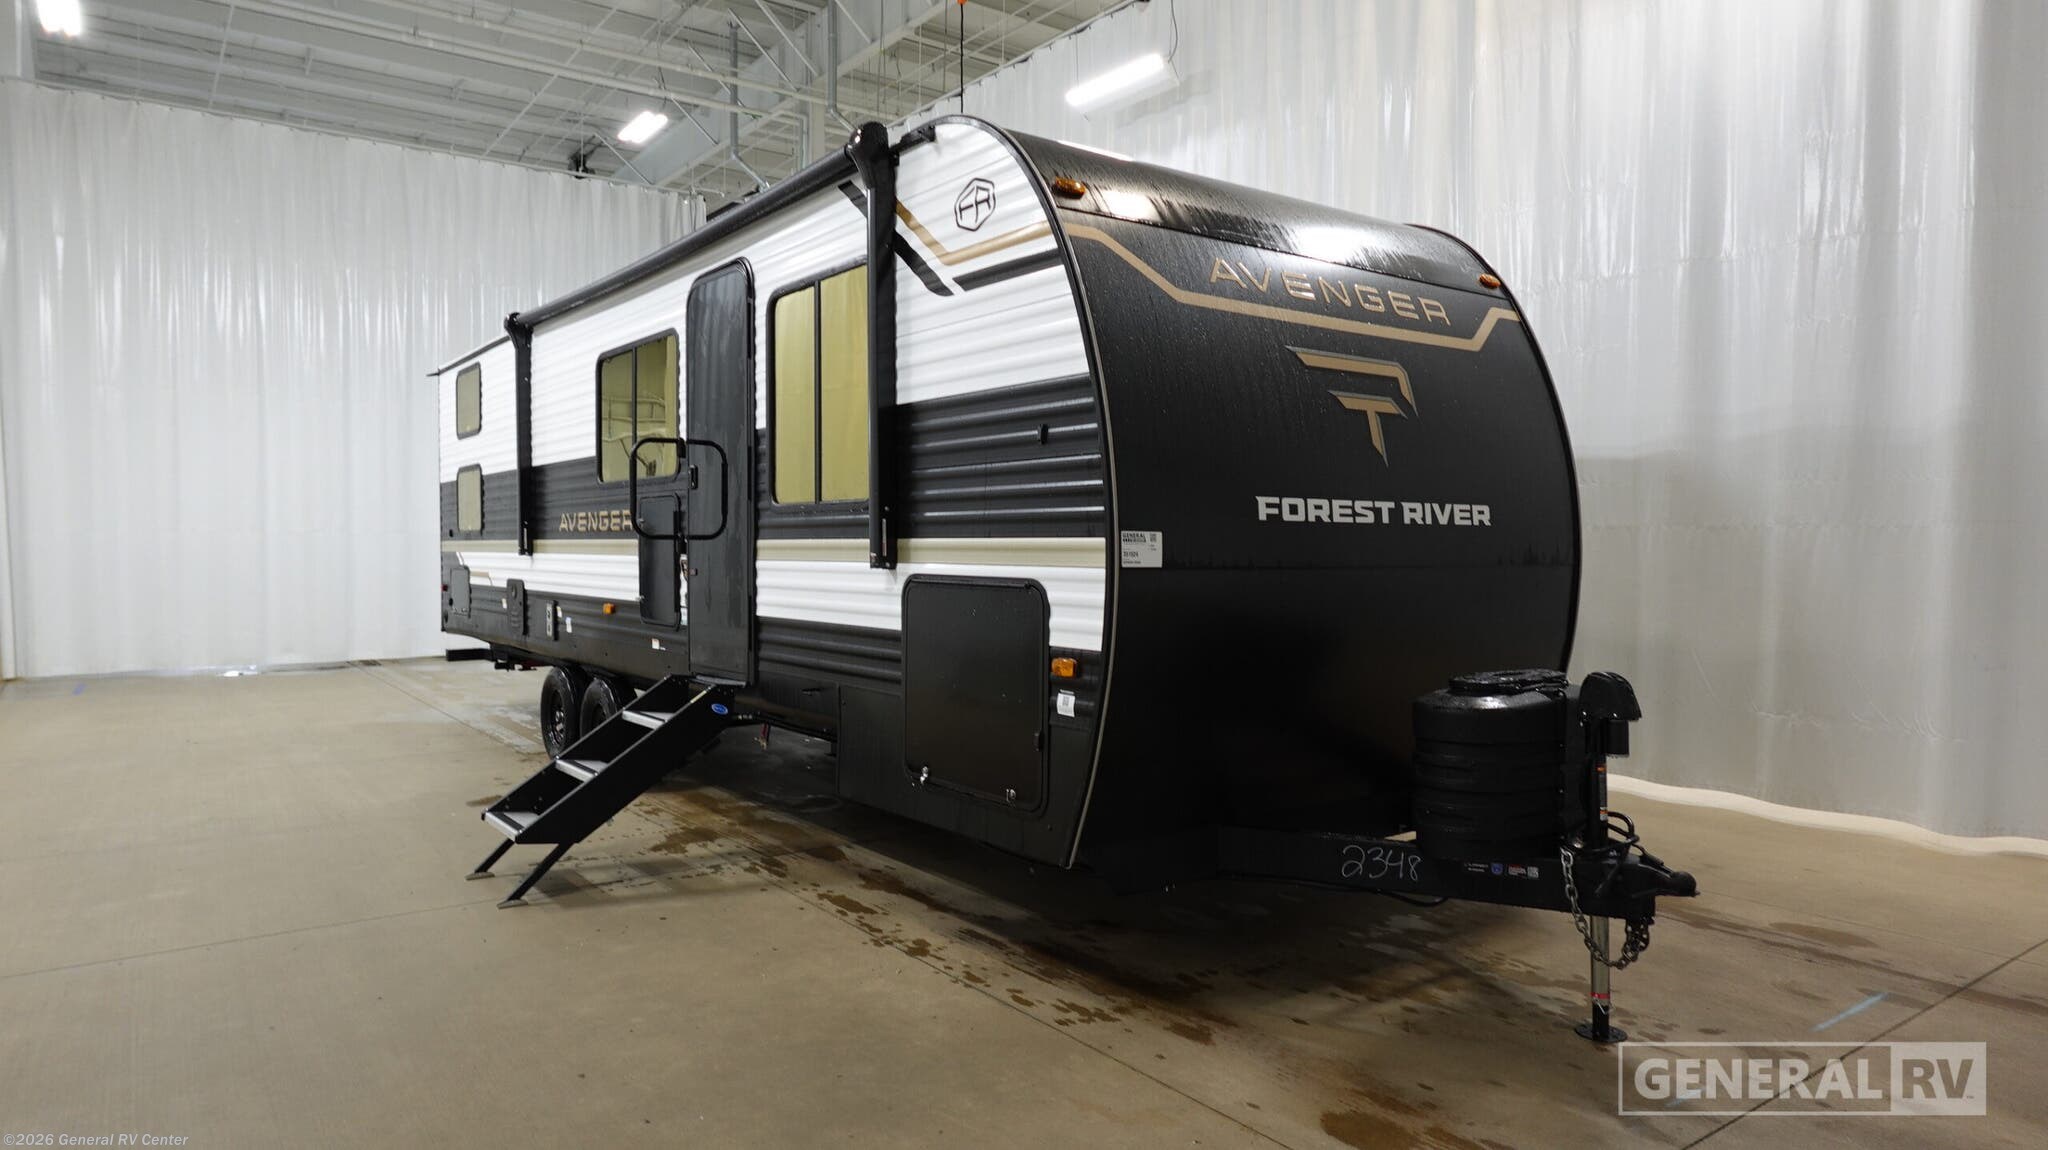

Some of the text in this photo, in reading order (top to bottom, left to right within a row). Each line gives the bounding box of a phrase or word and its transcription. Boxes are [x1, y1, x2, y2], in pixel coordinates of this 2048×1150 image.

[1209, 257, 1451, 327] AVENGER
[559, 509, 633, 532] AVENGER
[1255, 495, 1492, 527] FOREST RIVER
[1341, 844, 1422, 881] 2348
